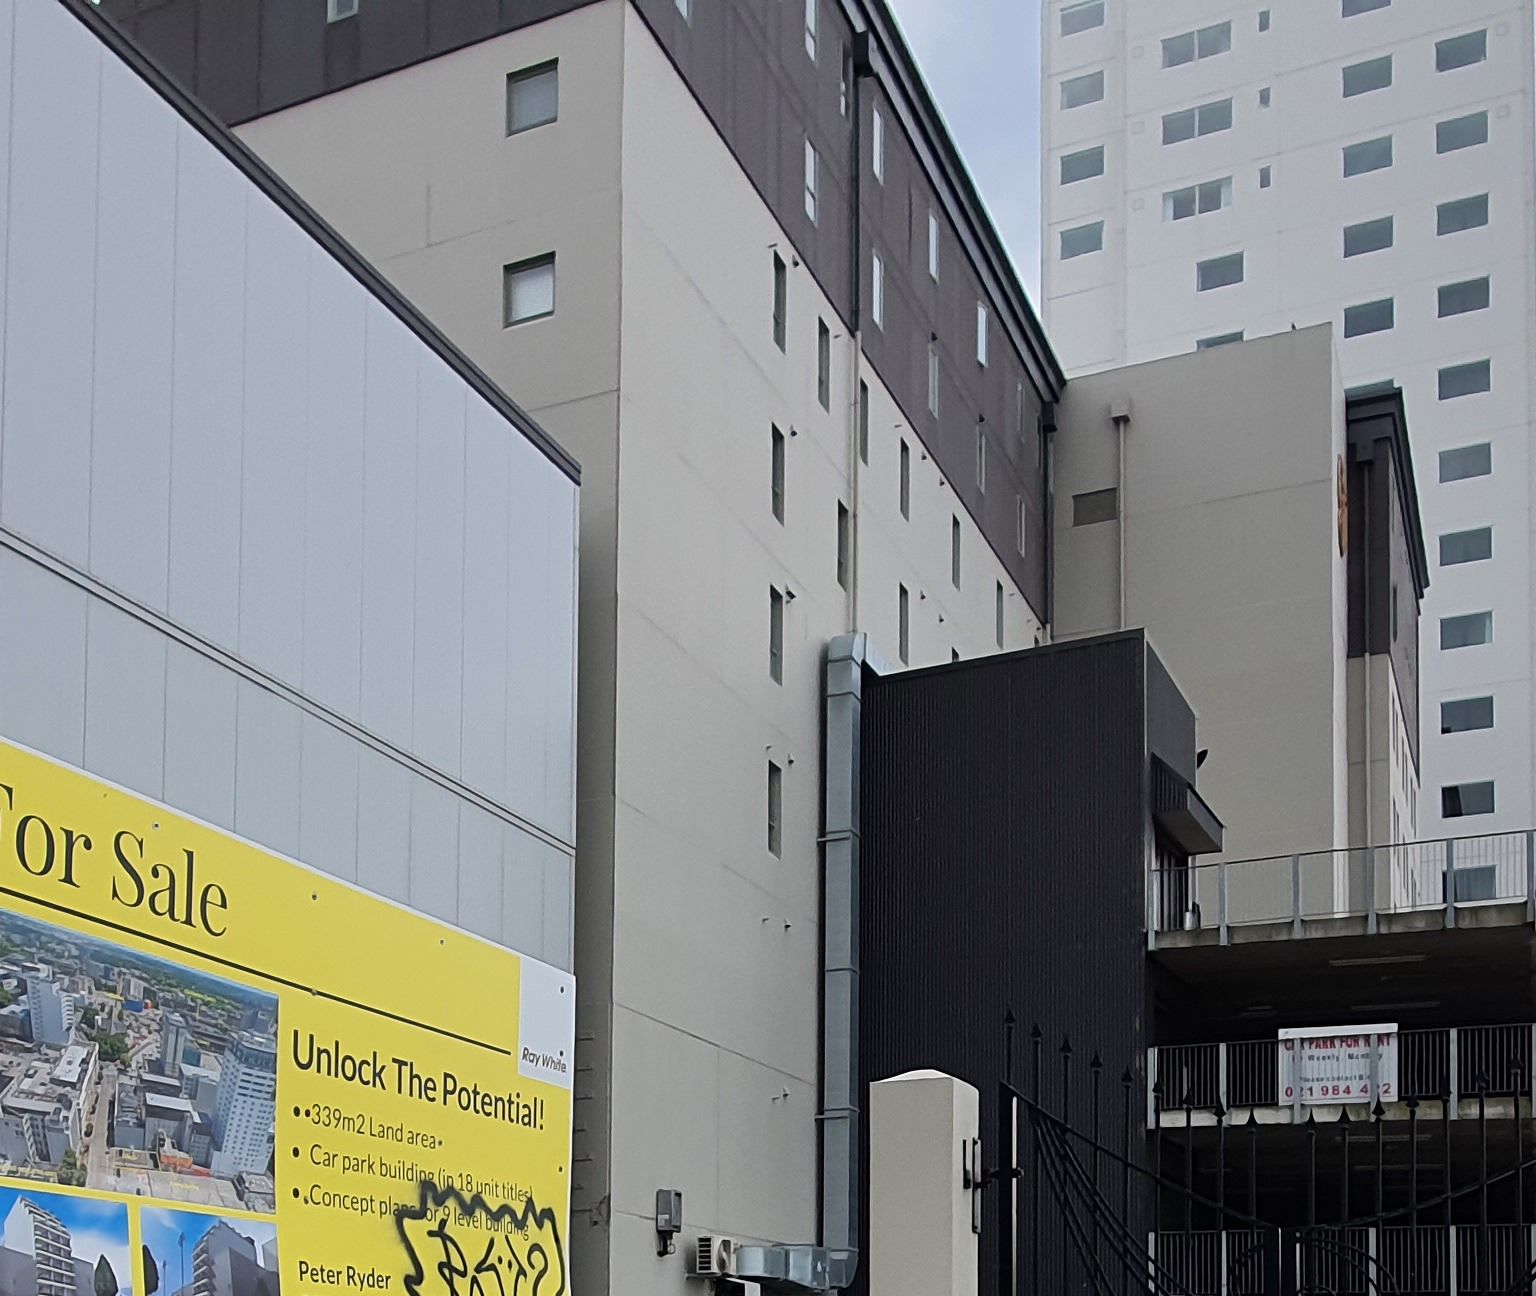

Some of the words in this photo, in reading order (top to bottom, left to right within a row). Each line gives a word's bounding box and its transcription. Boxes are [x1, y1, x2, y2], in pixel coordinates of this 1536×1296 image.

[111, 830, 229, 937] Sale
[521, 1046, 541, 1067] Ray
[541, 1055, 567, 1074] White
[1364, 1033, 1391, 1047] RNT
[292, 1029, 387, 1091] Unlock
[392, 1057, 437, 1103] The
[442, 1072, 545, 1131] Potential!
[1320, 1084, 1352, 1096] 984
[1359, 1082, 1392, 1095] 42
[310, 1103, 366, 1135] 339m2
[369, 1117, 404, 1143] Land
[407, 1128, 437, 1150] area
[309, 1144, 339, 1169] Car
[342, 1153, 375, 1175] park
[458, 1172, 473, 1193] 18
[476, 1178, 499, 1198] unit
[309, 1184, 375, 1216] Concept
[443, 1205, 451, 1222] 9
[454, 1206, 483, 1230] level
[298, 1260, 343, 1286] Peter
[346, 1266, 392, 1291] Ryder
